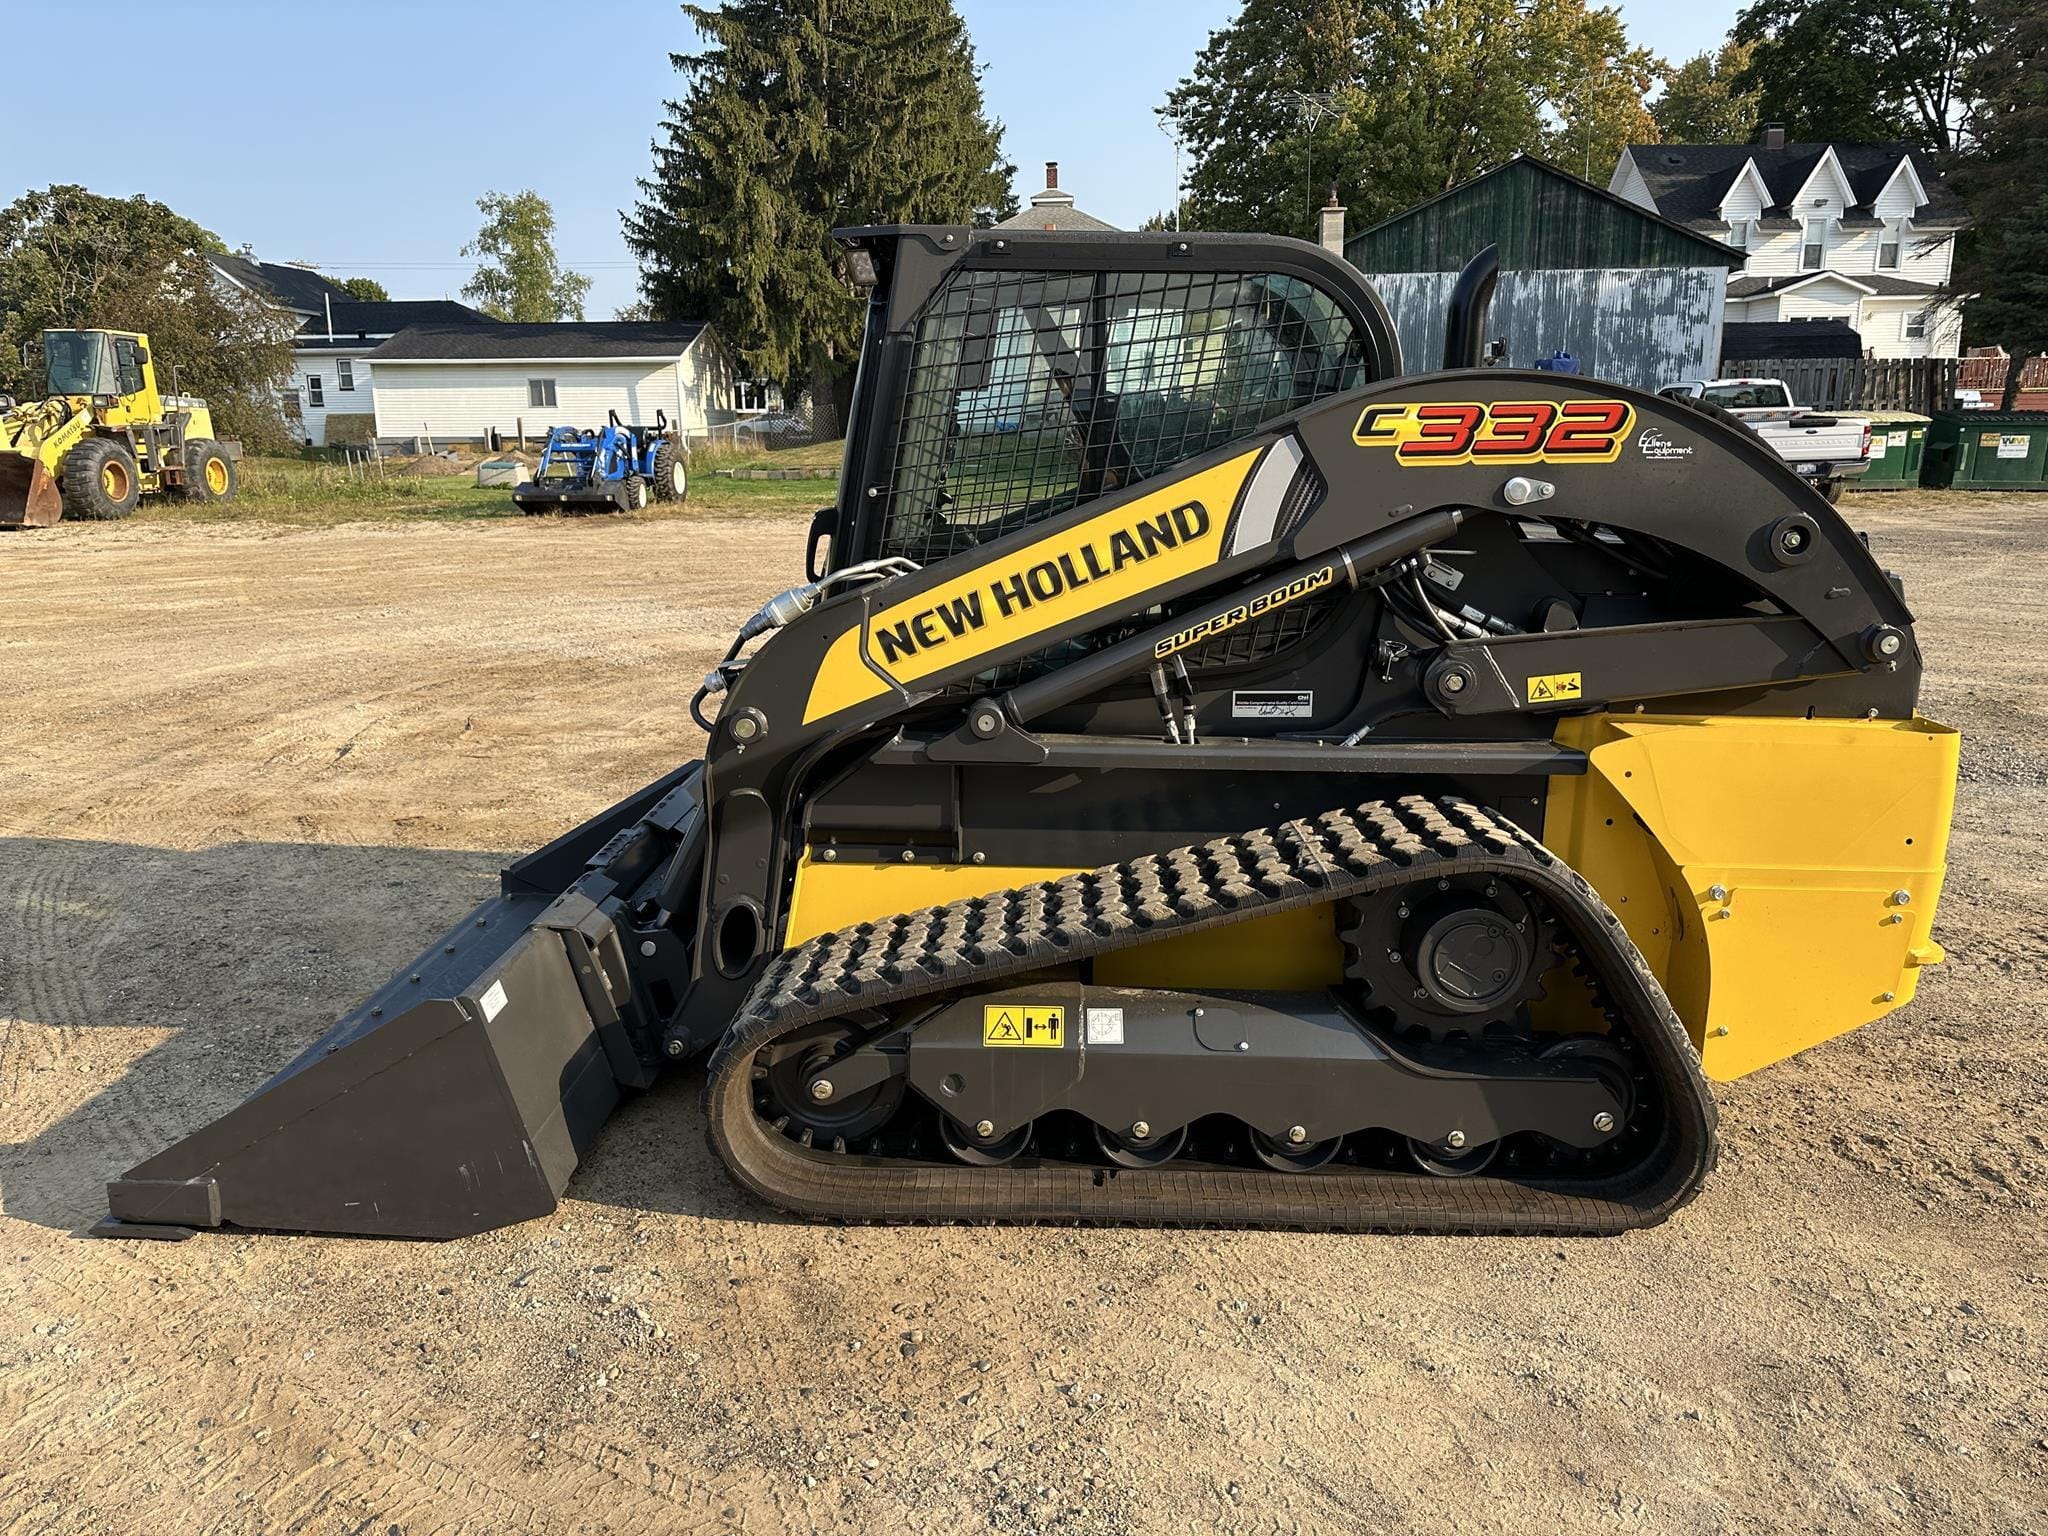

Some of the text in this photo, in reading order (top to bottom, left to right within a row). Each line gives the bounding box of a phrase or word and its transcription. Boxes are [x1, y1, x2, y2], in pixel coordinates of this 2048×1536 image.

[53, 421, 81, 448] KOMATSU
[1353, 401, 1635, 464] C332
[875, 499, 1212, 665] NEW HOLLAND
[1155, 566, 1333, 659] SUPER BOOM
